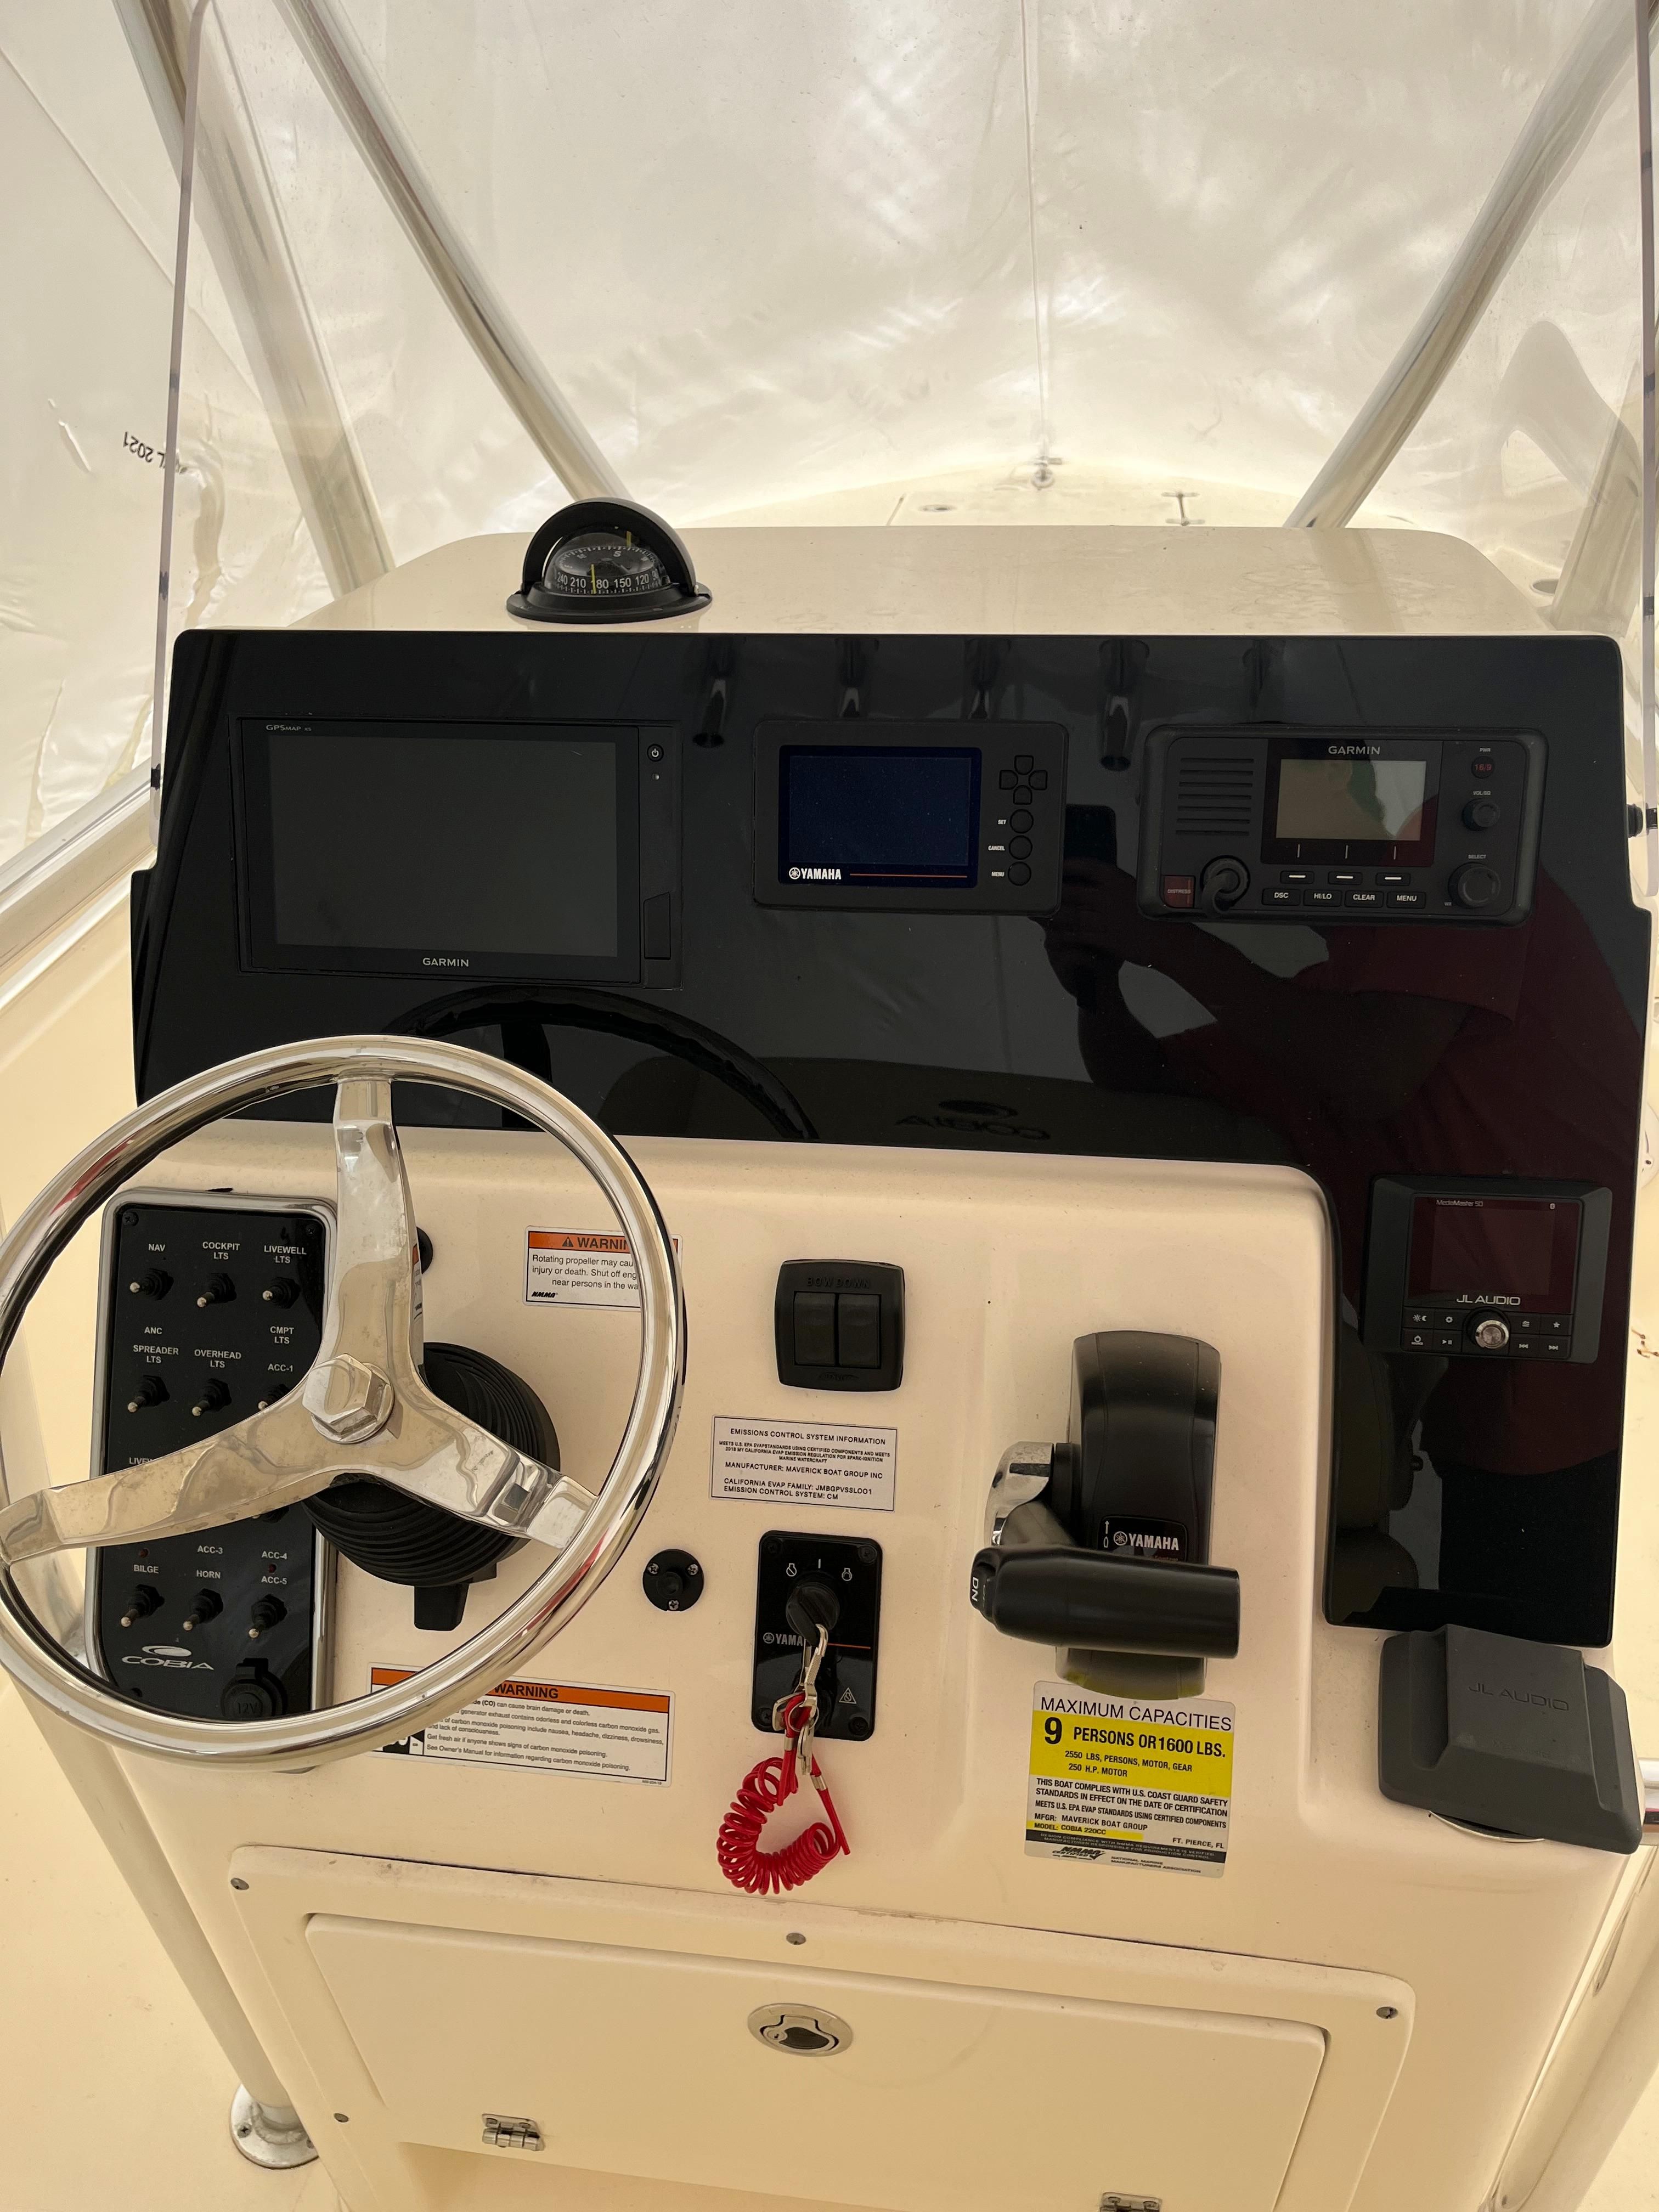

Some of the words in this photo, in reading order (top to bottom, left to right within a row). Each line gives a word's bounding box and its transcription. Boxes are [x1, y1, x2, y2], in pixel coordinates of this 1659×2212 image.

[123, 431, 153, 463] 2021
[557, 572, 568, 585] 240
[570, 573, 586, 589] 210
[590, 579, 609, 589] 80
[614, 577, 631, 588] 150
[635, 573, 650, 585] 120
[1328, 745, 1381, 755] GARMIN
[1474, 763, 1492, 771] 16/9
[801, 868, 842, 880] YAMAHA
[1313, 892, 1332, 900] HI/LO
[1352, 893, 1375, 901] CLEAR
[1396, 894, 1417, 902] MENU
[422, 956, 470, 967] GARMIN
[148, 1243, 166, 1252] NAV
[202, 1241, 240, 1251] COCKPIT
[577, 1237, 630, 1250] WARNIN
[213, 1252, 229, 1260] LTS
[264, 1245, 307, 1256] LIVEWELL
[275, 1255, 291, 1264] LTS
[532, 1254, 563, 1265] Rotating
[566, 1256, 599, 1266] propeller
[532, 1266, 552, 1275] injury
[571, 1280, 602, 1289] persons
[807, 1277, 833, 1287] BOW
[836, 1278, 870, 1288] DOWN
[1457, 1294, 1473, 1303] JL
[1475, 1295, 1521, 1305] AUDIO
[144, 1326, 162, 1335] ANC
[270, 1326, 295, 1335] CMPT
[274, 1336, 290, 1345] LTS
[133, 1345, 179, 1356] SPREADER
[194, 1349, 242, 1360] OVERHEAD
[146, 1355, 161, 1364] LTS
[210, 1360, 225, 1368] LTS
[267, 1363, 294, 1372] ACC-1
[730, 1428, 768, 1436] EMISSIONS
[770, 1431, 804, 1439] CONTROL
[836, 1436, 885, 1445] INFORMATION
[725, 1461, 783, 1471] MANUFACTURER:
[786, 1466, 821, 1474] MAVERICK
[724, 1477, 766, 1486] CALIFORNIA
[724, 1485, 757, 1493] EMISSION
[759, 1488, 793, 1496] CONTROL
[1128, 1533, 1180, 1551] YAMAHA
[197, 1545, 223, 1554] ACC-3
[261, 1550, 287, 1560] ACC-4
[133, 1564, 159, 1574] BILGE
[196, 1570, 221, 1579] HORN
[261, 1576, 287, 1585] ACC-5
[972, 1576, 979, 1602] DN
[775, 1633, 803, 1646] YAMA
[121, 1656, 215, 1671] COBIA
[494, 1682, 558, 1699] WARNING
[1469, 1682, 1493, 1696] JL
[1500, 1688, 1569, 1711] AUDIO
[238, 1701, 259, 1715] 12V
[541, 1706, 564, 1714] damage
[1041, 1696, 1124, 1719] MAXIMUM
[1129, 1706, 1232, 1731] CAPACITIES
[1043, 1716, 1063, 1745] 9
[1073, 1726, 1135, 1747] PERSONS
[1196, 1740, 1226, 1757] LBS.
[1065, 1750, 1082, 1759] 2550
[1086, 1752, 1102, 1762] LBS,
[1104, 1754, 1139, 1767] PERSONS,
[1142, 1759, 1170, 1770] MOTOR,
[1172, 1762, 1192, 1771] GEAR
[1068, 1763, 1082, 1771] 250
[1085, 1765, 1099, 1774] H.P.
[1101, 1767, 1127, 1777] MOTOR
[1036, 1778, 1052, 1786] THIS
[1054, 1780, 1073, 1788] BOAT
[1074, 1782, 1110, 1793] COMPLIES
[1112, 1787, 1130, 1796] WITH
[1132, 1789, 1146, 1797] U.S.
[1147, 1791, 1171, 1800] COAST
[1173, 1793, 1198, 1803] GUARD
[1200, 1797, 1228, 1807] SAFETY
[1036, 1787, 1079, 1799] STANDARDS
[1089, 1793, 1115, 1803] EFFECT
[1144, 1800, 1162, 1809] DATE
[1174, 1803, 1227, 1816] CERTIFICATION
[1035, 1799, 1054, 1808] MEETS
[1081, 1805, 1096, 1813] EVAP
[1097, 1807, 1132, 1818] STANDARDS
[1134, 1811, 1152, 1820] USING
[1154, 1814, 1184, 1824] CERTIFIED
[1185, 1817, 1226, 1829] COMPONENTS
[1034, 1813, 1057, 1821] MFGR:
[1062, 1815, 1099, 1825] MAVERICK
[1101, 1819, 1120, 1828] BOAT
[1122, 1822, 1148, 1831] GROUP
[1060, 1824, 1082, 1832] COBIA
[1084, 1827, 1106, 1835] 220CC
[1185, 1839, 1214, 1848] PIERCE,
